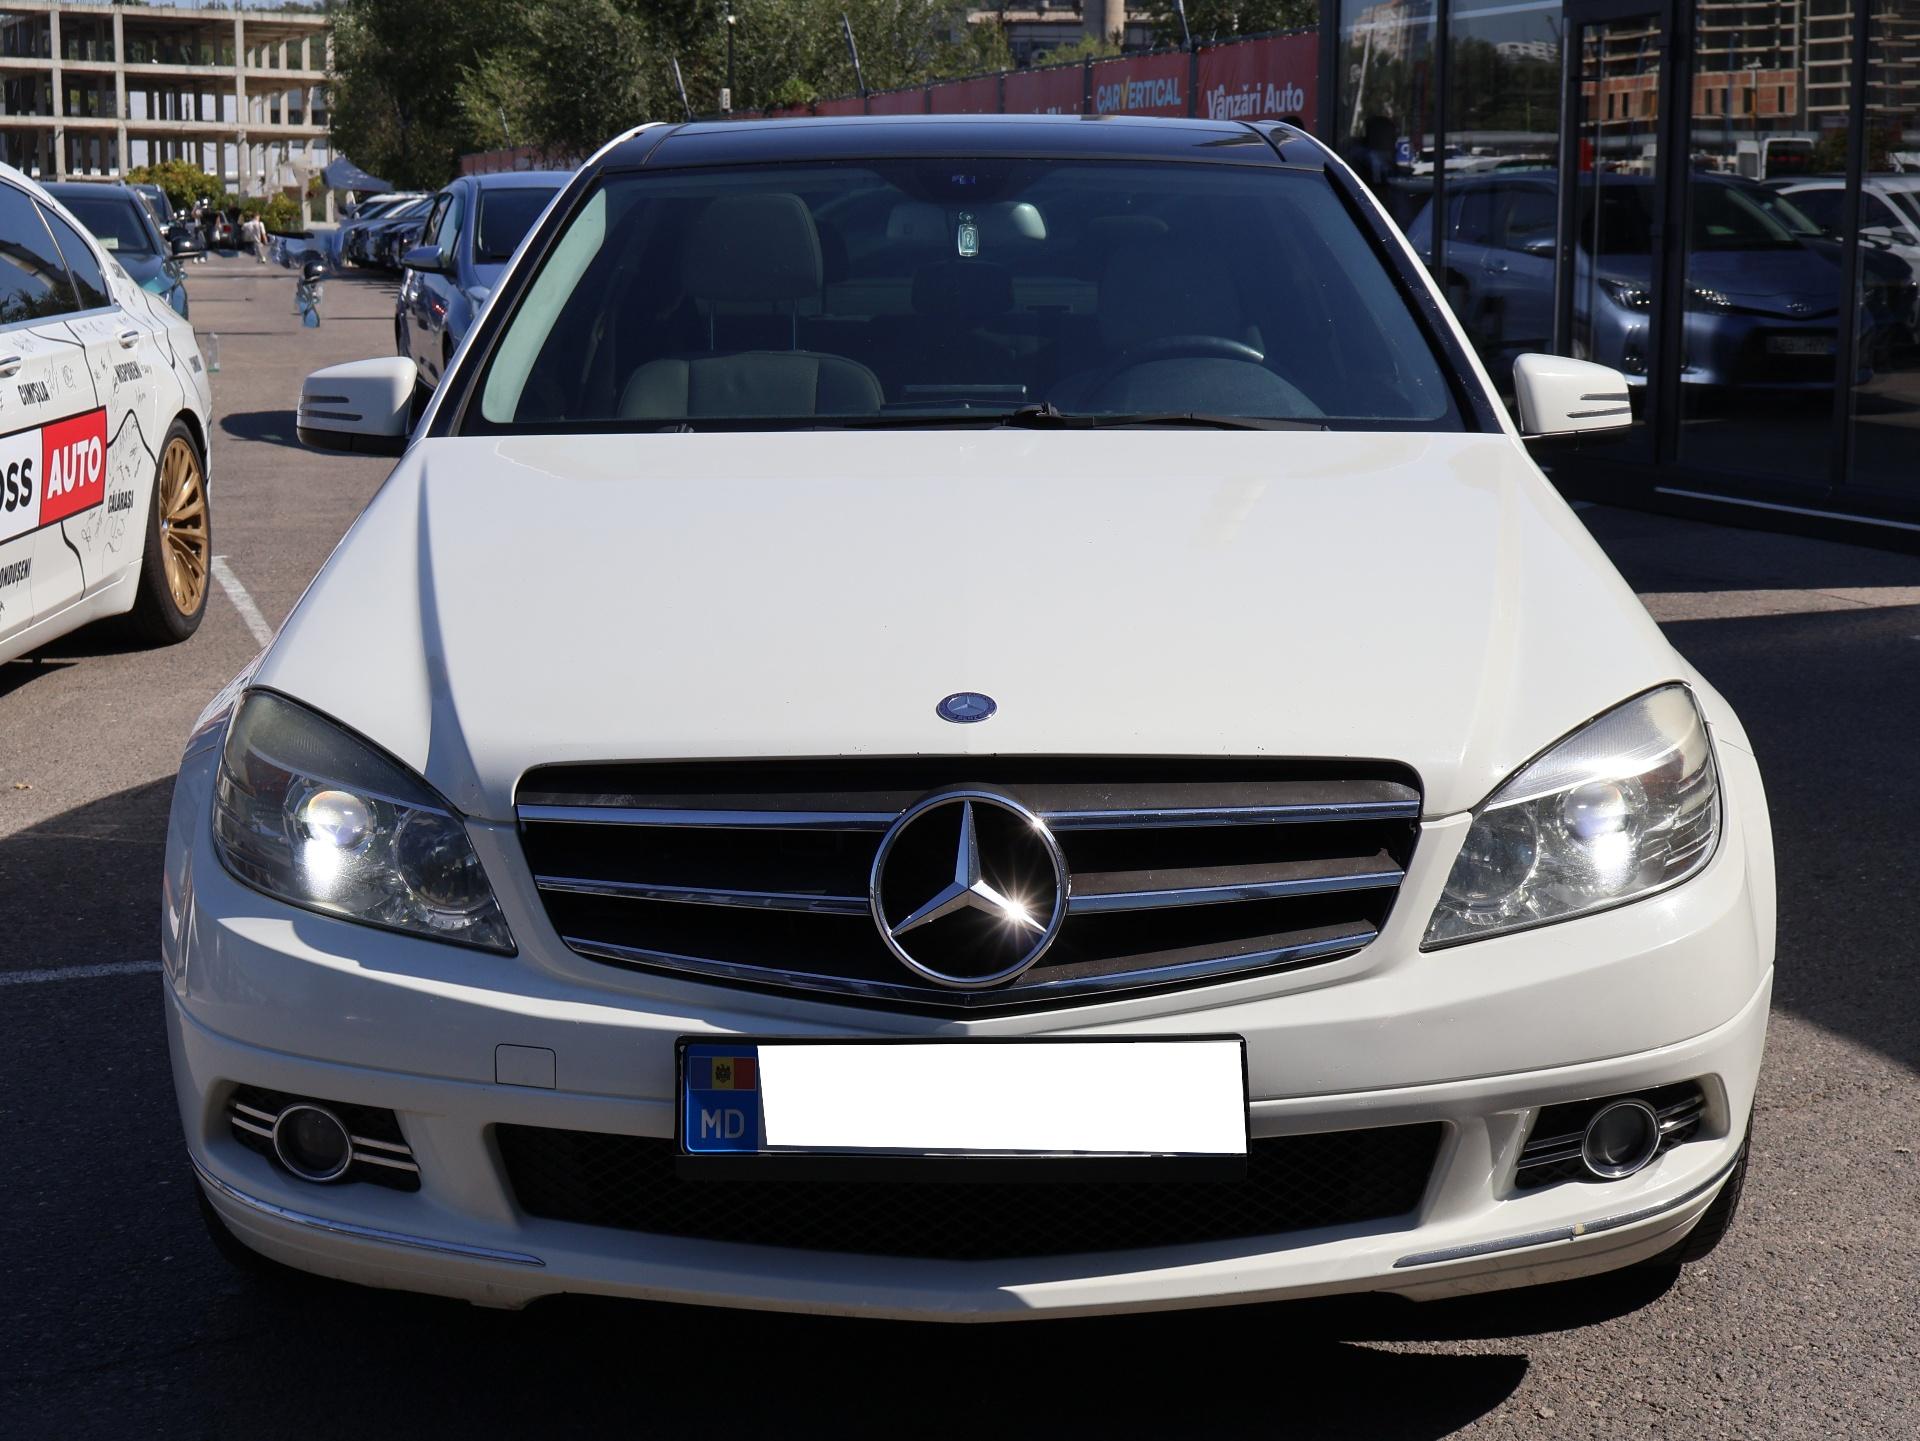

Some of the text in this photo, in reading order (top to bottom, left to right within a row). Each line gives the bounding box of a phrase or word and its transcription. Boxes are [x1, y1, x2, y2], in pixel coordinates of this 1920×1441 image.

[1097, 77, 1182, 113] CARVERTICAL
[1207, 82, 1304, 120] Vânzări Auto
[47, 436, 102, 500] AUTO
[701, 1108, 745, 1139] MD
